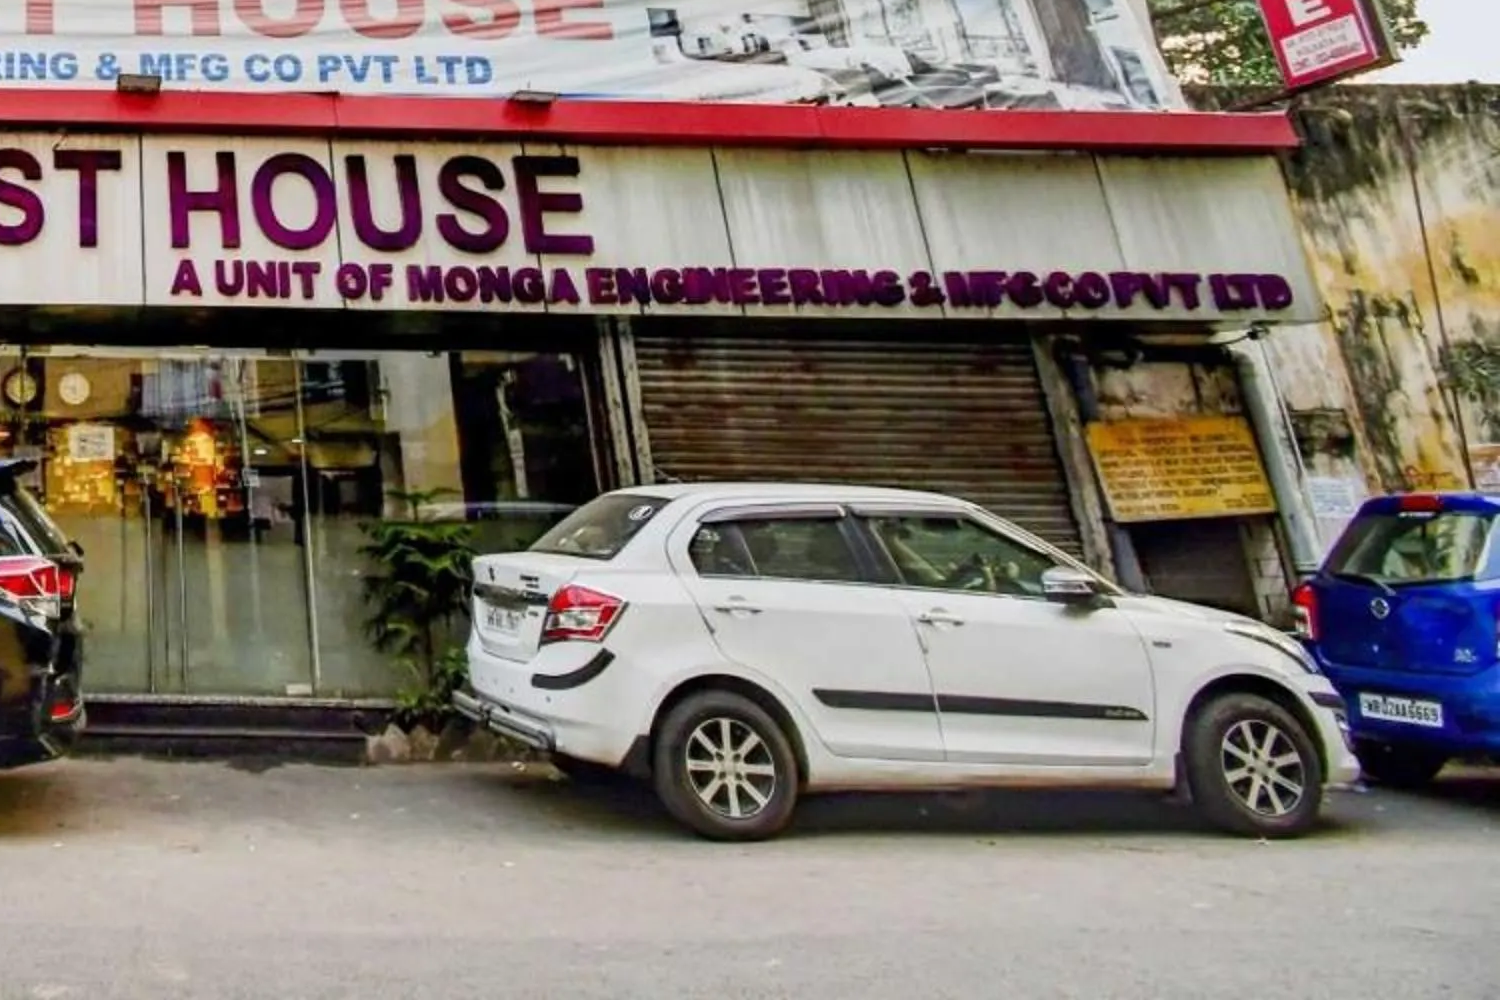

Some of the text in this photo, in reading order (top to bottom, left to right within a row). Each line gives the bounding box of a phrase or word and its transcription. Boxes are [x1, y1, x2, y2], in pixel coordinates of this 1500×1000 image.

[94, 54, 121, 81] &
[140, 53, 230, 83] MFG
[243, 54, 303, 84] CO
[317, 55, 400, 85] PVT
[415, 56, 494, 86] LTD
[165, 150, 596, 257] HOUSE
[171, 259, 202, 297] A
[215, 260, 321, 300] UNIT
[336, 263, 394, 301] OF
[405, 264, 581, 305] MONGA
[586, 266, 905, 308] ENGINEERING
[908, 270, 947, 308] &
[1108, 272, 1201, 311] PVT
[1208, 273, 1293, 312] LTD
